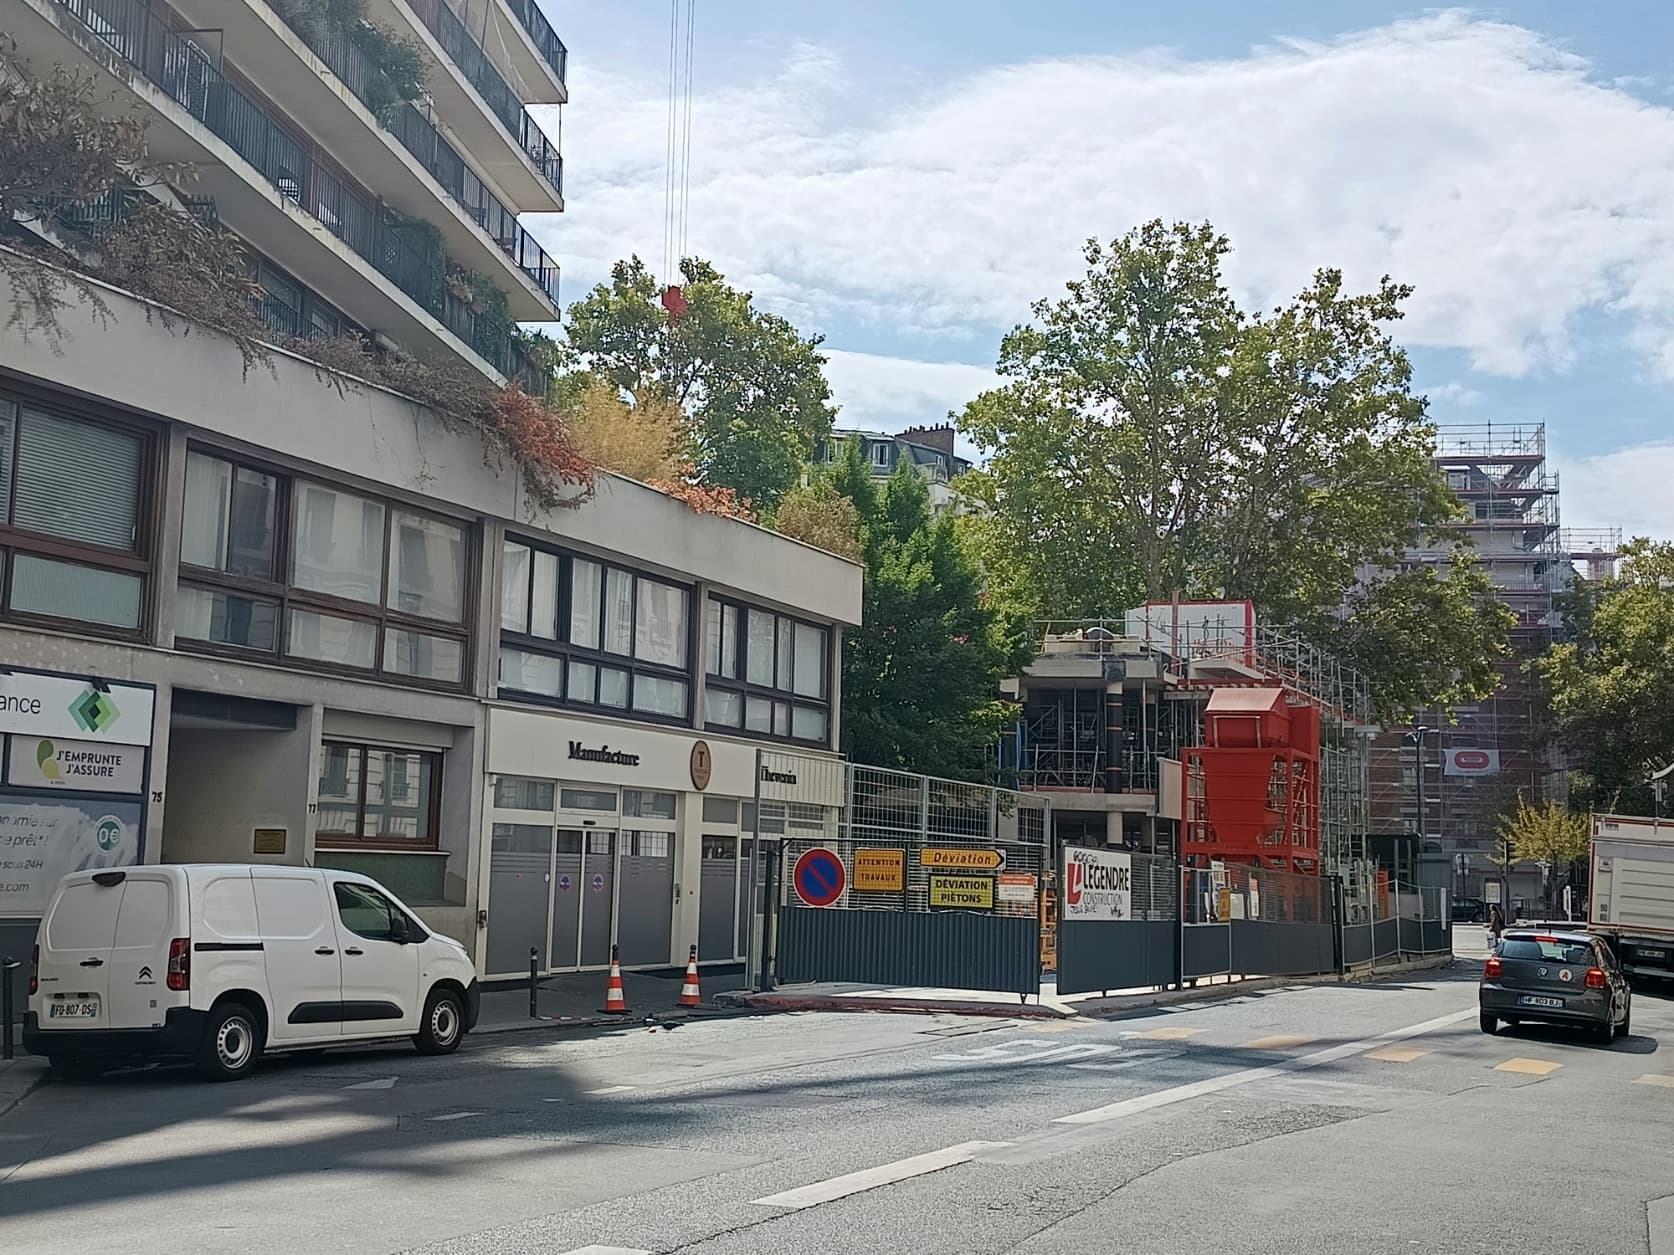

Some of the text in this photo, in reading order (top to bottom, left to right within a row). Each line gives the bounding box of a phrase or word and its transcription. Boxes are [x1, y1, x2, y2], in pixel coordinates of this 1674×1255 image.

[56, 750, 122, 766] J'EMPRUNTE
[567, 740, 640, 767] Manufacture
[65, 764, 114, 778] J'ASSURE
[152, 791, 163, 803] 75
[857, 858, 900, 866] ATTENTION
[933, 852, 991, 865] Déviation
[860, 873, 896, 881] TRAVAUX
[935, 877, 988, 890] DÉVIATION
[1083, 862, 1129, 892] LEGENDRE
[1082, 891, 1123, 906] CONSTRUCTION
